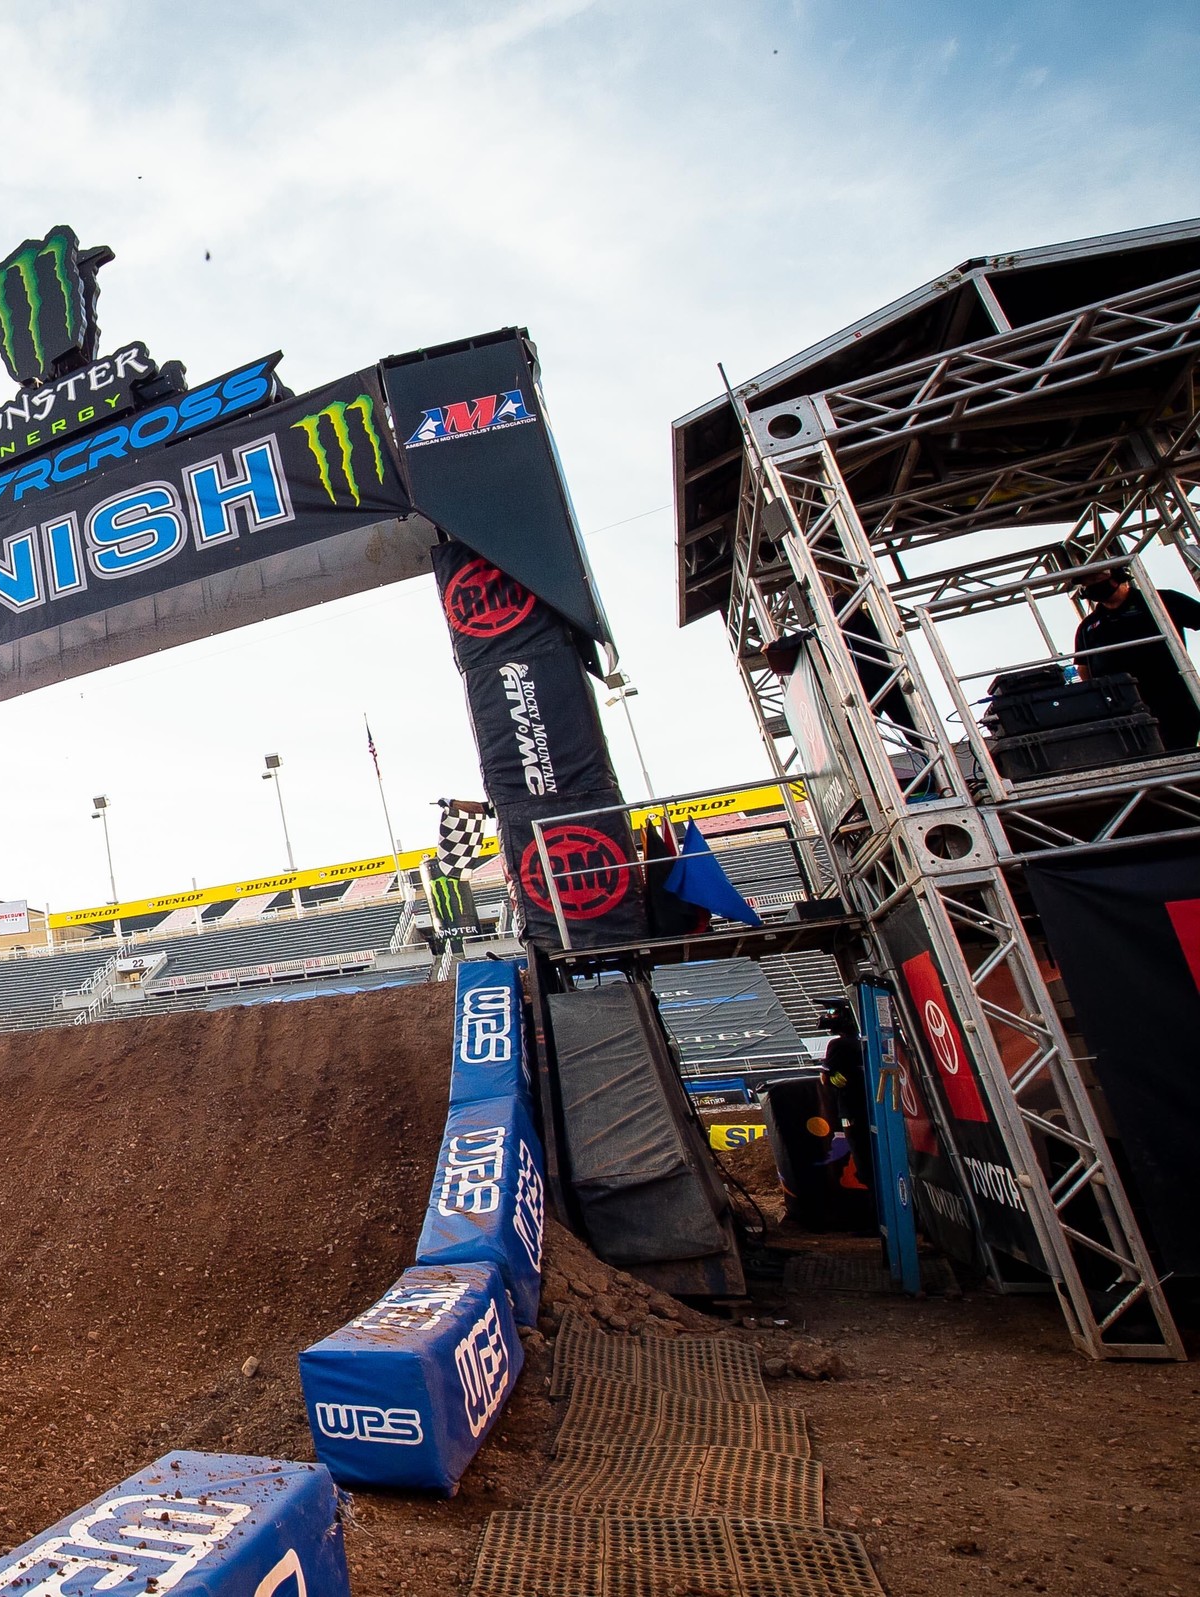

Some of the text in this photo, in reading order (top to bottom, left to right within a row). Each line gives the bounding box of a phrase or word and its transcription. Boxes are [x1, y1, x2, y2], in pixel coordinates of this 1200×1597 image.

[404, 389, 536, 446] AMA
[405, 416, 537, 450] AMERICAN MOTORCYCLIST ASSOCIATION
[522, 679, 558, 794] ROCKY MOUNTAIN
[244, 876, 298, 892] DUNLOP
[329, 860, 386, 877] DUNLOP
[74, 908, 121, 921] DUNLOP
[156, 893, 204, 907] DUNLOP
[132, 958, 145, 968] 22
[460, 985, 511, 1064] WPS
[437, 1126, 506, 1217] WPS
[963, 1156, 1026, 1213] TOYOTA
[315, 1402, 424, 1446] WPS
